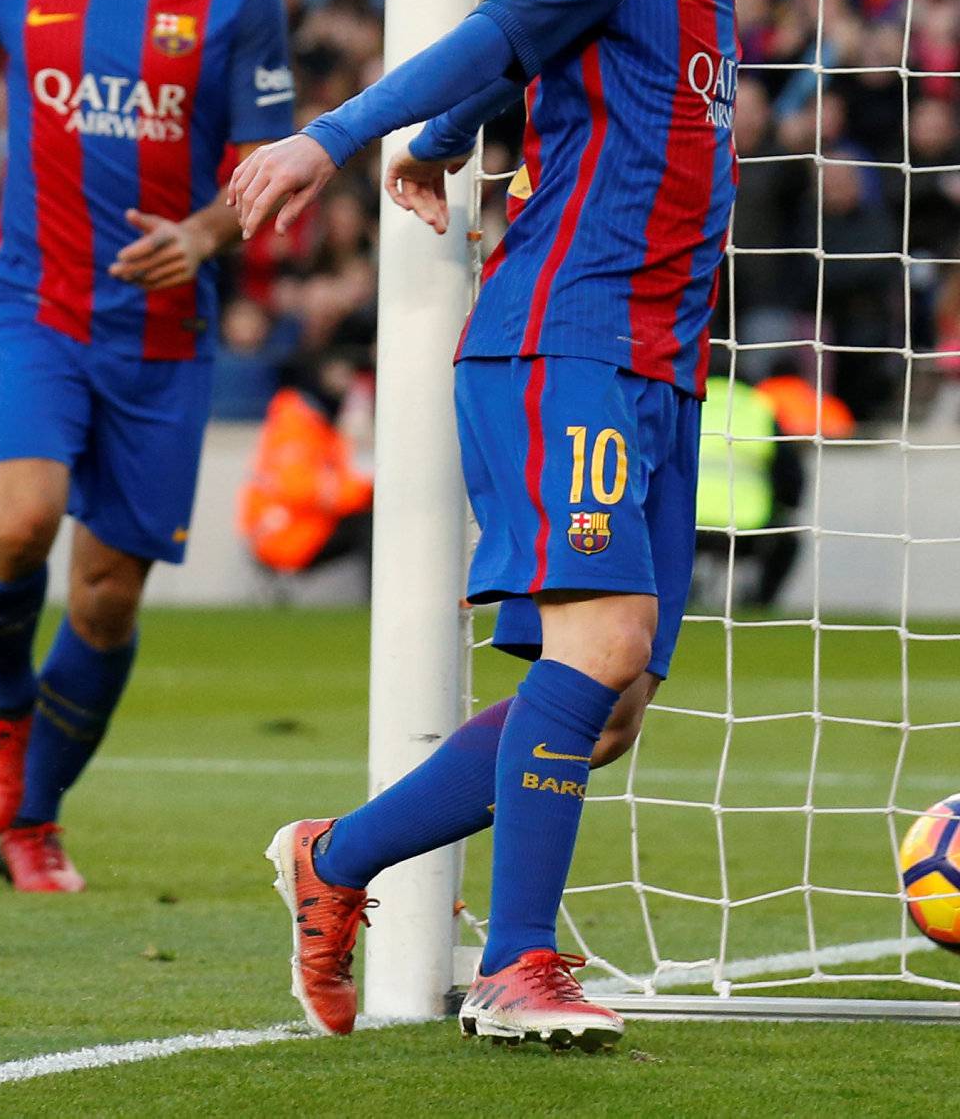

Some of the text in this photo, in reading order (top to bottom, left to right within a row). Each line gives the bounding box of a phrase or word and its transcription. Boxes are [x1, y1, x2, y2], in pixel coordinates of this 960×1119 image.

[34, 67, 187, 119] QATAR
[64, 109, 185, 143] AIRWAYS
[566, 426, 628, 506] 10
